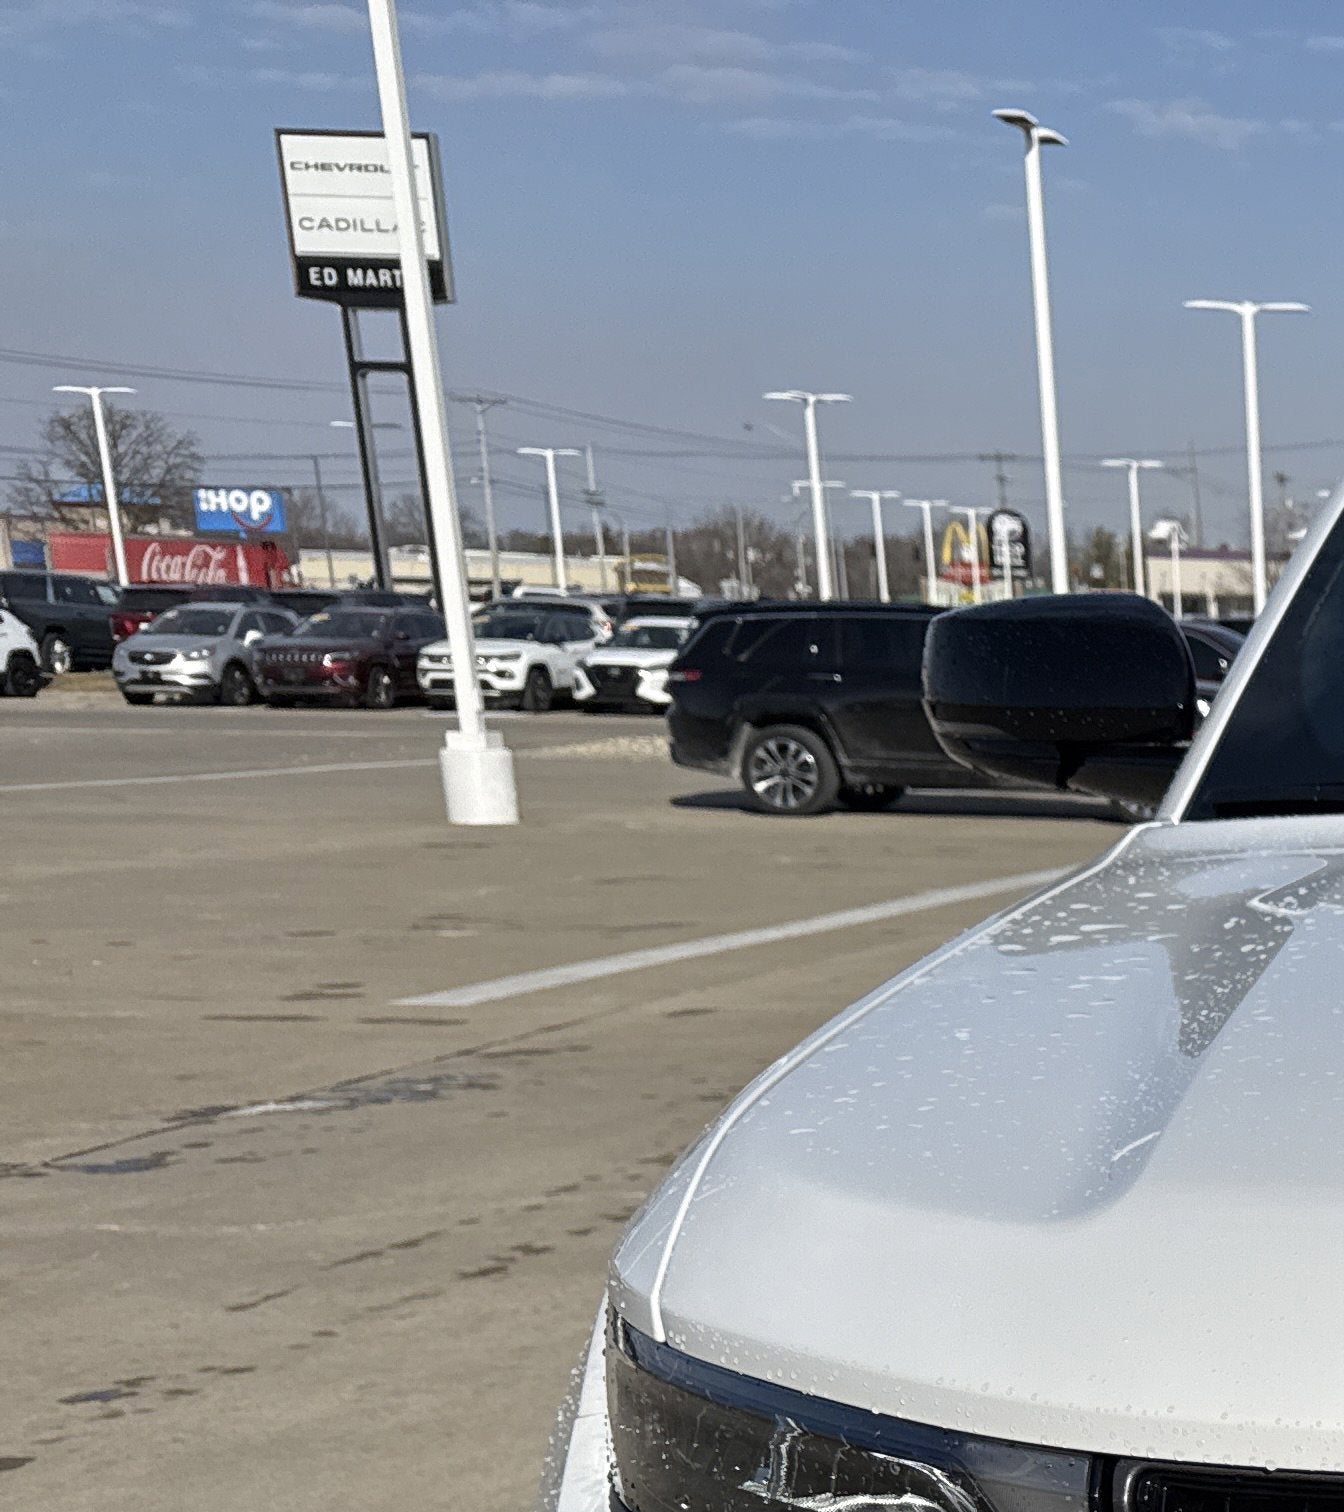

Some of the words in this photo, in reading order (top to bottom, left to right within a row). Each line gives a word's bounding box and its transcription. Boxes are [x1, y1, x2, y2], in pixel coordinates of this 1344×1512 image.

[289, 160, 420, 175] CHEVROL
[308, 266, 339, 287] ED
[346, 267, 403, 289] MART
